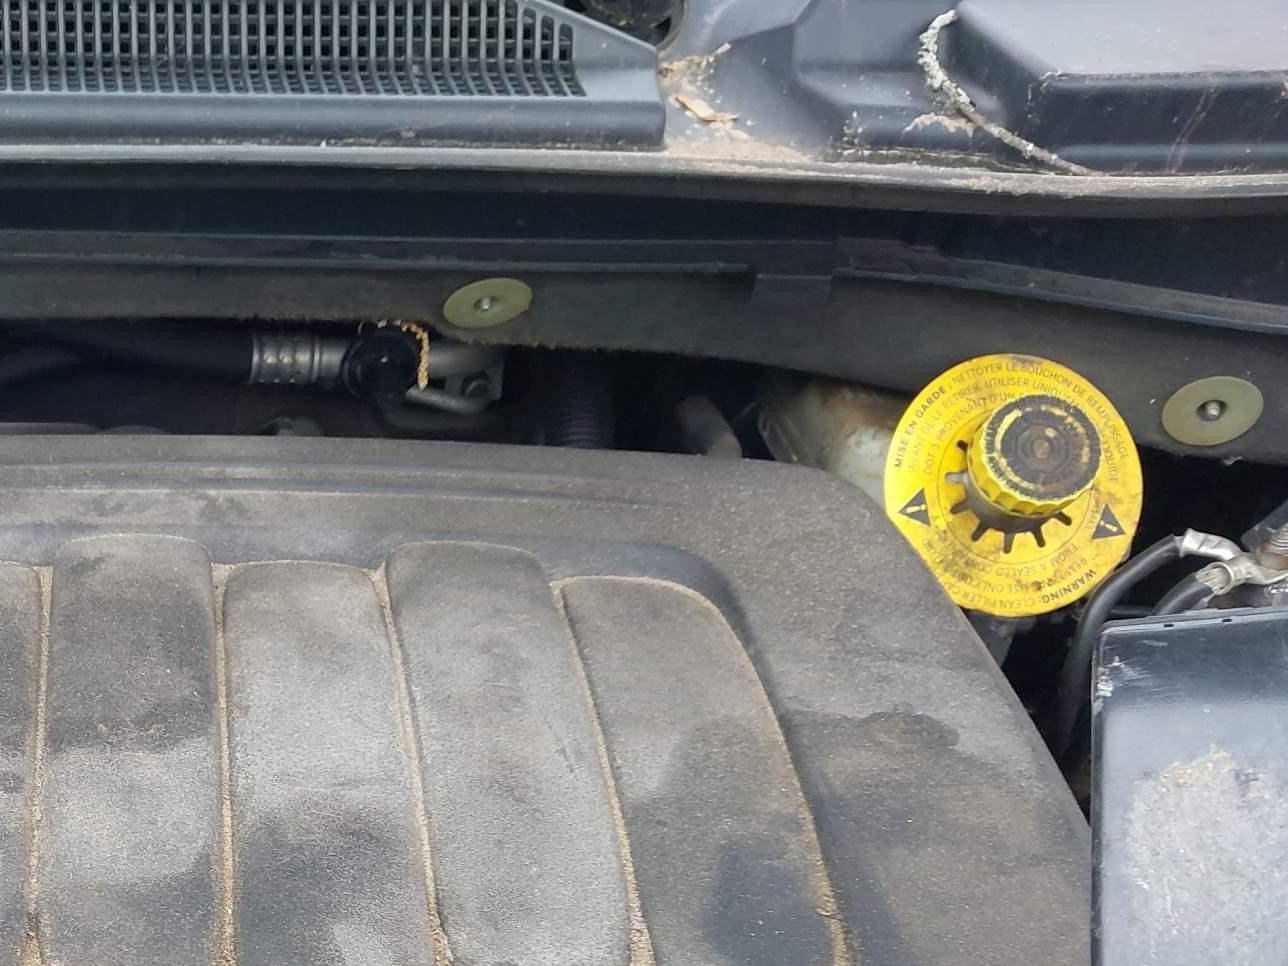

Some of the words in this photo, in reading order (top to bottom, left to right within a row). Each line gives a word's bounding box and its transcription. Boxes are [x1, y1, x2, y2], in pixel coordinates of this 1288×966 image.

[982, 375, 1031, 390] UTILISER
[893, 437, 909, 468] MISE
[902, 418, 918, 437] EN
[912, 384, 946, 420] GARDE
[950, 361, 1002, 387] NETTOYER
[1004, 363, 1018, 372] LE
[1020, 364, 1074, 389] BOUCHON
[1071, 382, 1088, 399] DE
[1036, 564, 1099, 605] WARNING:
